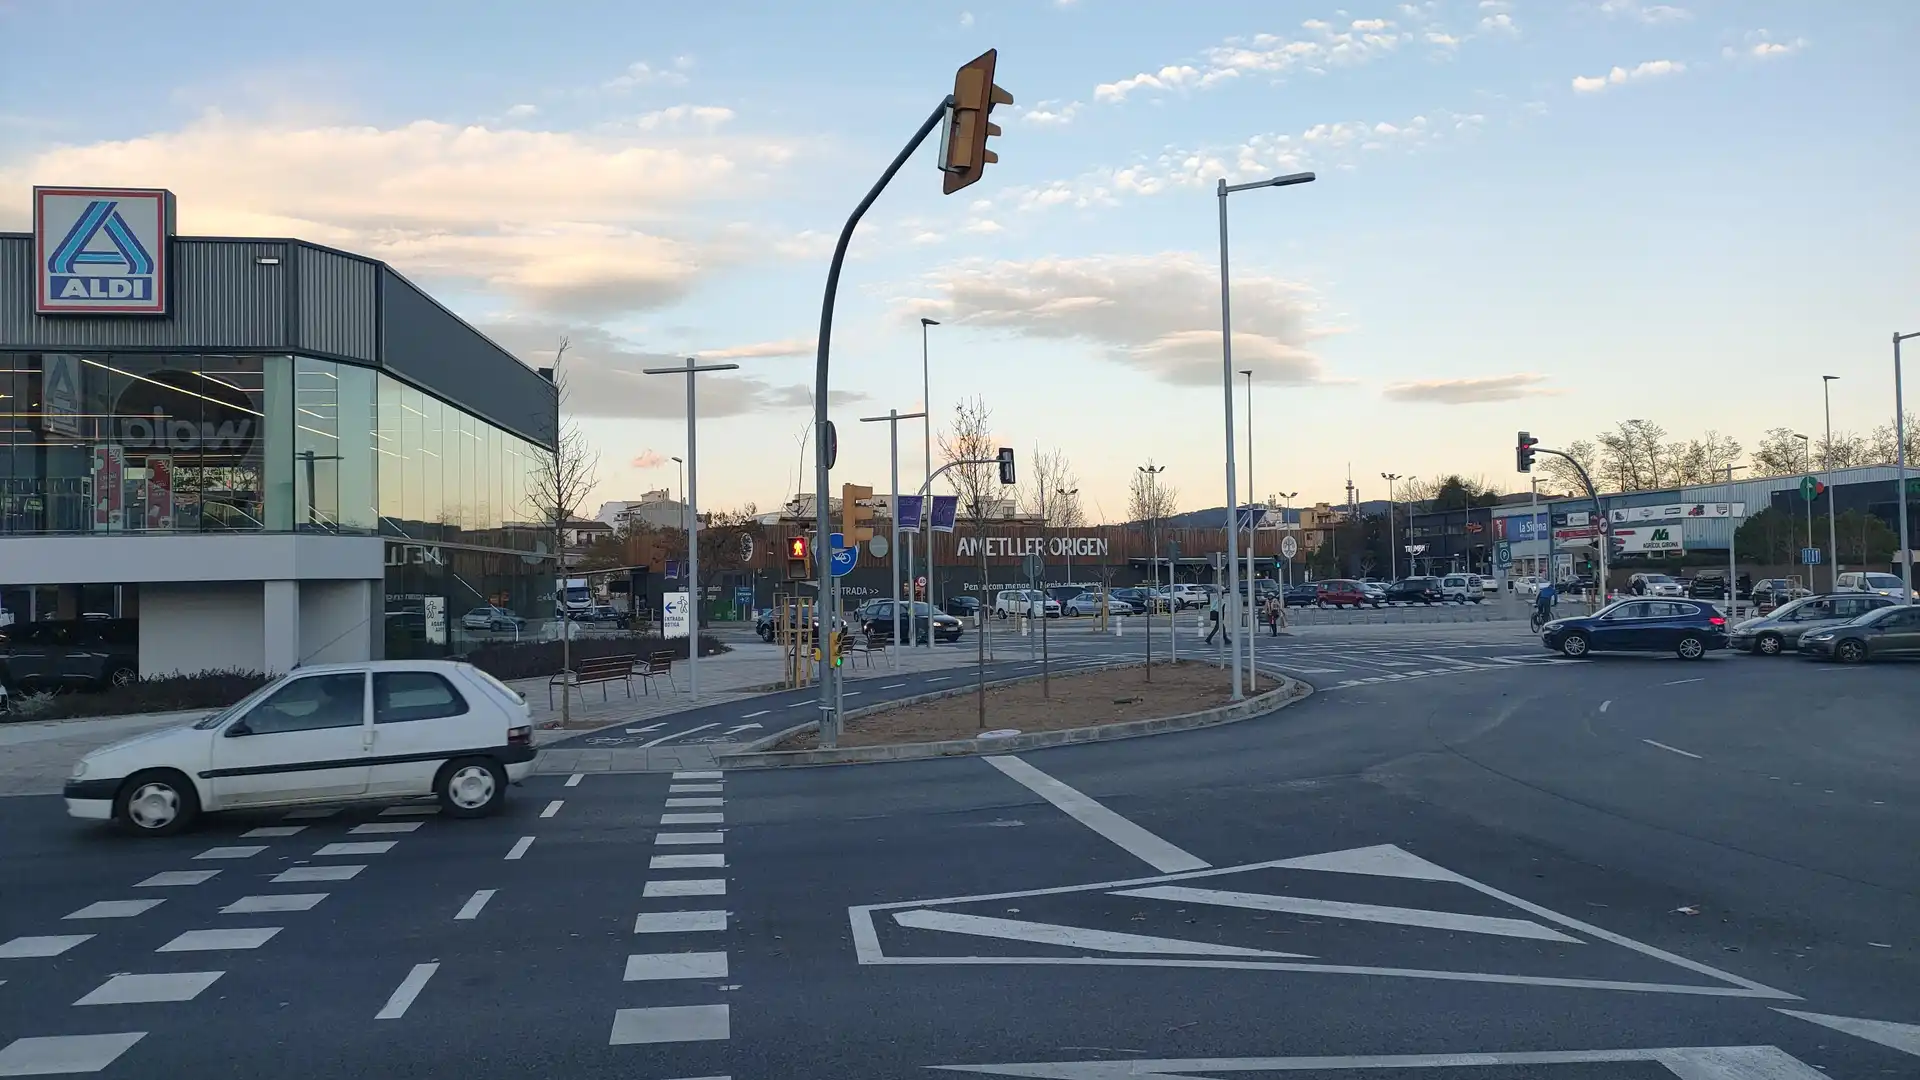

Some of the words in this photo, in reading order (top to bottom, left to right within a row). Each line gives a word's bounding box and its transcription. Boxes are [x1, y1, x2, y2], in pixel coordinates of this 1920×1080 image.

[60, 279, 143, 298] ALDI
[957, 537, 1047, 556] AMETLLER
[1050, 538, 1108, 556] ORIGEN
